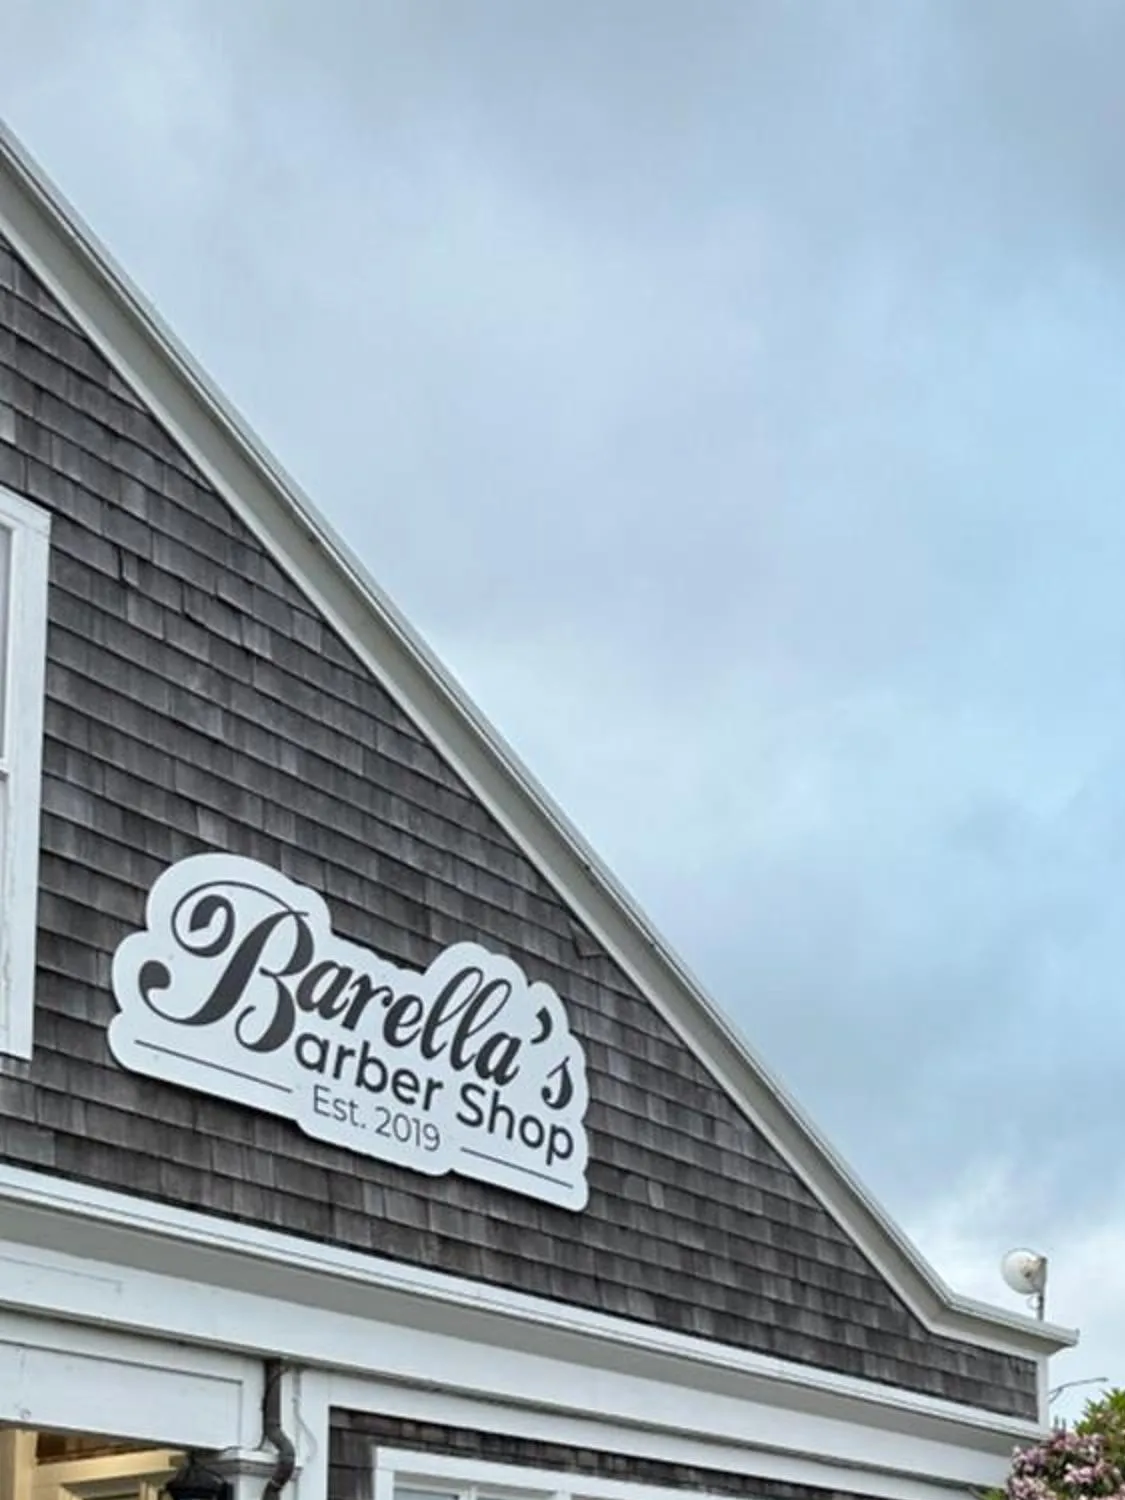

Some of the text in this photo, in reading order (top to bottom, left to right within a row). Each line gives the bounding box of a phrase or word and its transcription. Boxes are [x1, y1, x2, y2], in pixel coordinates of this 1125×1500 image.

[138, 880, 575, 1111] Barella's
[313, 1085, 441, 1152] Est. 2019
[457, 1085, 574, 1166] Shop
